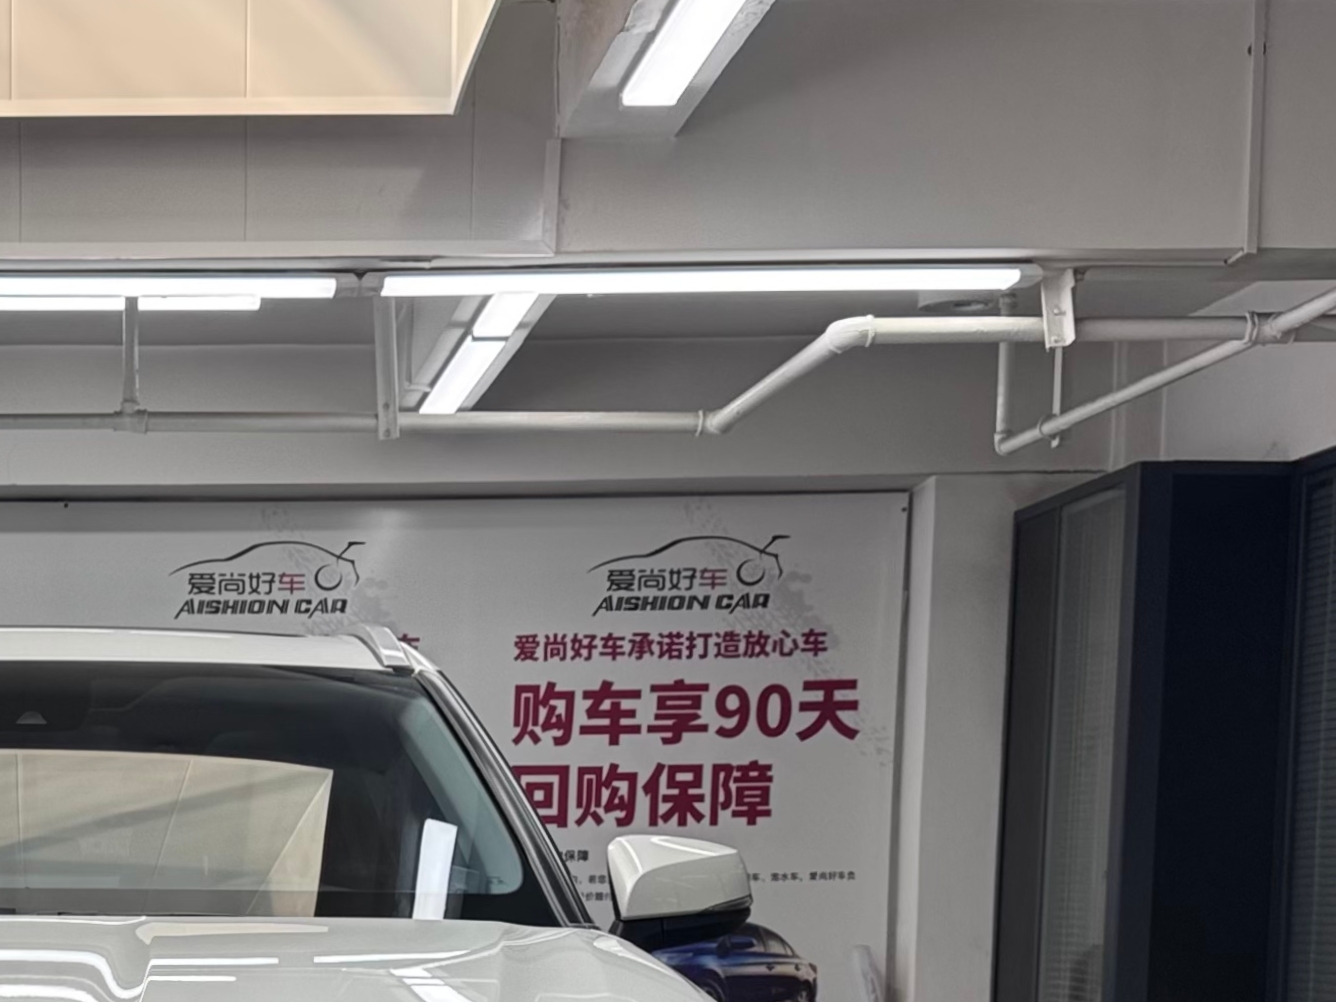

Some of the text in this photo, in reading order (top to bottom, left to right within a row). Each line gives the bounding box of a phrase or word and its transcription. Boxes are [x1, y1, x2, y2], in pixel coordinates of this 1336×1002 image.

[187, 571, 306, 596] 爱尚好车
[606, 566, 728, 592] 爱尚好车
[174, 594, 348, 620] AISHION CAR
[592, 592, 771, 617] AISHION CAR
[513, 628, 829, 662] 爱尚好车承诺打造放心车
[511, 678, 861, 747] 购车享90天
[513, 759, 774, 828] 回购保障
[560, 850, 590, 863] 保障
